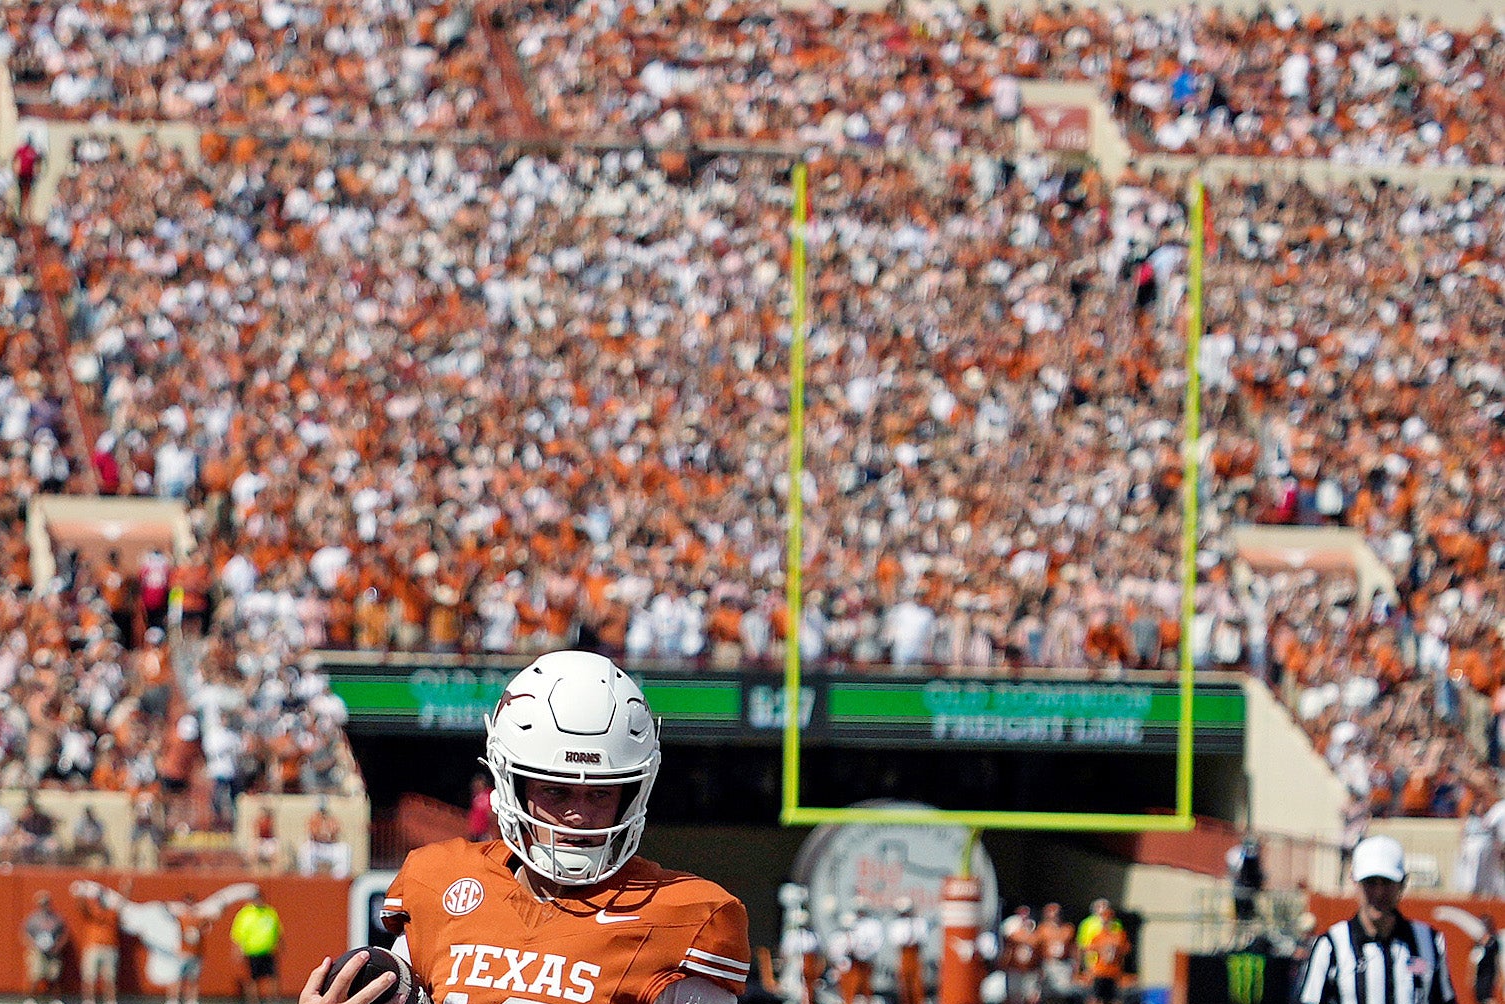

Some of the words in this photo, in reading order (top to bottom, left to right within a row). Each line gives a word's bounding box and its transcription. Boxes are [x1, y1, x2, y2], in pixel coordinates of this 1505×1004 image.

[565, 751, 601, 766] HORNS
[444, 879, 482, 913] SEC
[445, 944, 602, 1004] TEXAS
